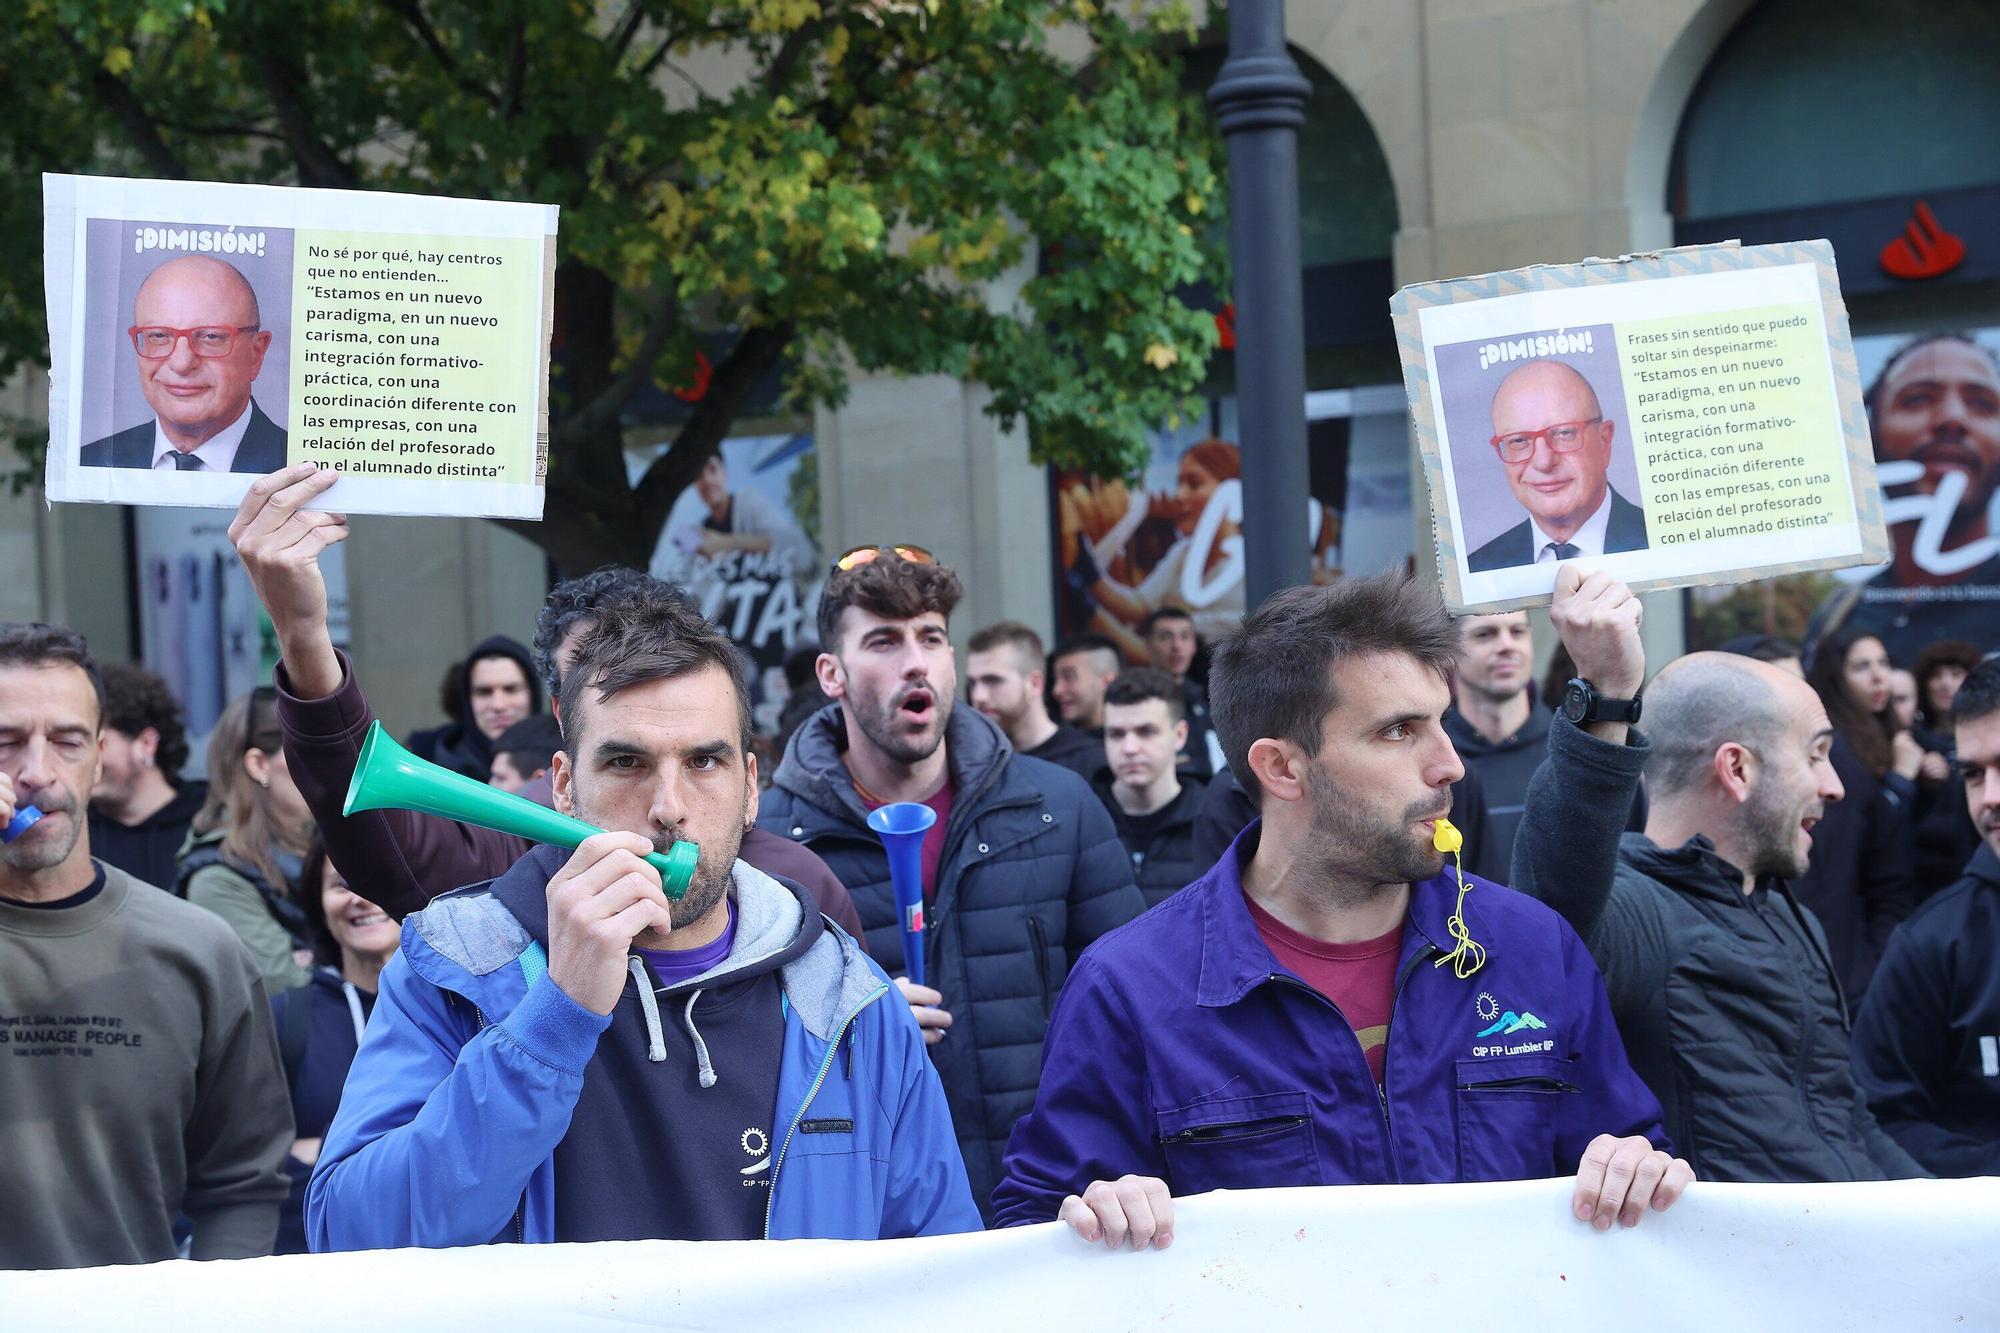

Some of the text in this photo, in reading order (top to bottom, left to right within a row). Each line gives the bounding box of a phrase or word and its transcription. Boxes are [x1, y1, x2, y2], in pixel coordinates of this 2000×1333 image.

[135, 225, 265, 257] ¡DIMISIÓN!
[309, 246, 502, 266] No sé por qué, hay centros
[308, 268, 335, 280] que
[340, 269, 357, 278] no
[385, 291, 404, 301] en
[410, 293, 429, 303] un
[435, 294, 482, 305] nuevo
[307, 308, 498, 327] paradigma, en un nuevo
[306, 329, 439, 346] carisma, con una
[1628, 316, 1807, 344] Frases sin sentido que puedo
[305, 349, 483, 369] integración formativo-
[1479, 328, 1594, 370] ¡DIMISIÓN!
[1632, 340, 1777, 363] soltar sin despeinarme:
[1701, 366, 1717, 375] en
[1722, 363, 1738, 373] un
[1743, 358, 1783, 370] nuevo
[304, 371, 439, 389] práctica, con una
[1638, 377, 1800, 406] paradigma, en un nuevo
[304, 394, 516, 413] coordinación diferente con
[1642, 402, 1755, 423] carisma, con una
[303, 414, 477, 433] las empresas, con una
[1644, 418, 1795, 444] integración formativo-
[303, 436, 495, 456] relación del profesorado
[1648, 442, 1763, 467] práctica, con una
[334, 459, 347, 471] el
[352, 459, 432, 475] alumnado
[1651, 457, 1804, 484] coordinación diferente
[1655, 474, 1830, 504] con las empresas, con una
[1658, 494, 1822, 524] relación del profesorado
[1661, 533, 1685, 544] con
[1689, 528, 1700, 541] el
[1705, 520, 1773, 539] alumnado
[14, 1030, 78, 1043] MANAGE
[86, 1030, 142, 1047] PEOPLE
[1473, 1046, 1488, 1057] CIP
[1490, 1046, 1503, 1056] FP
[1505, 1042, 1543, 1055] Lumbier
